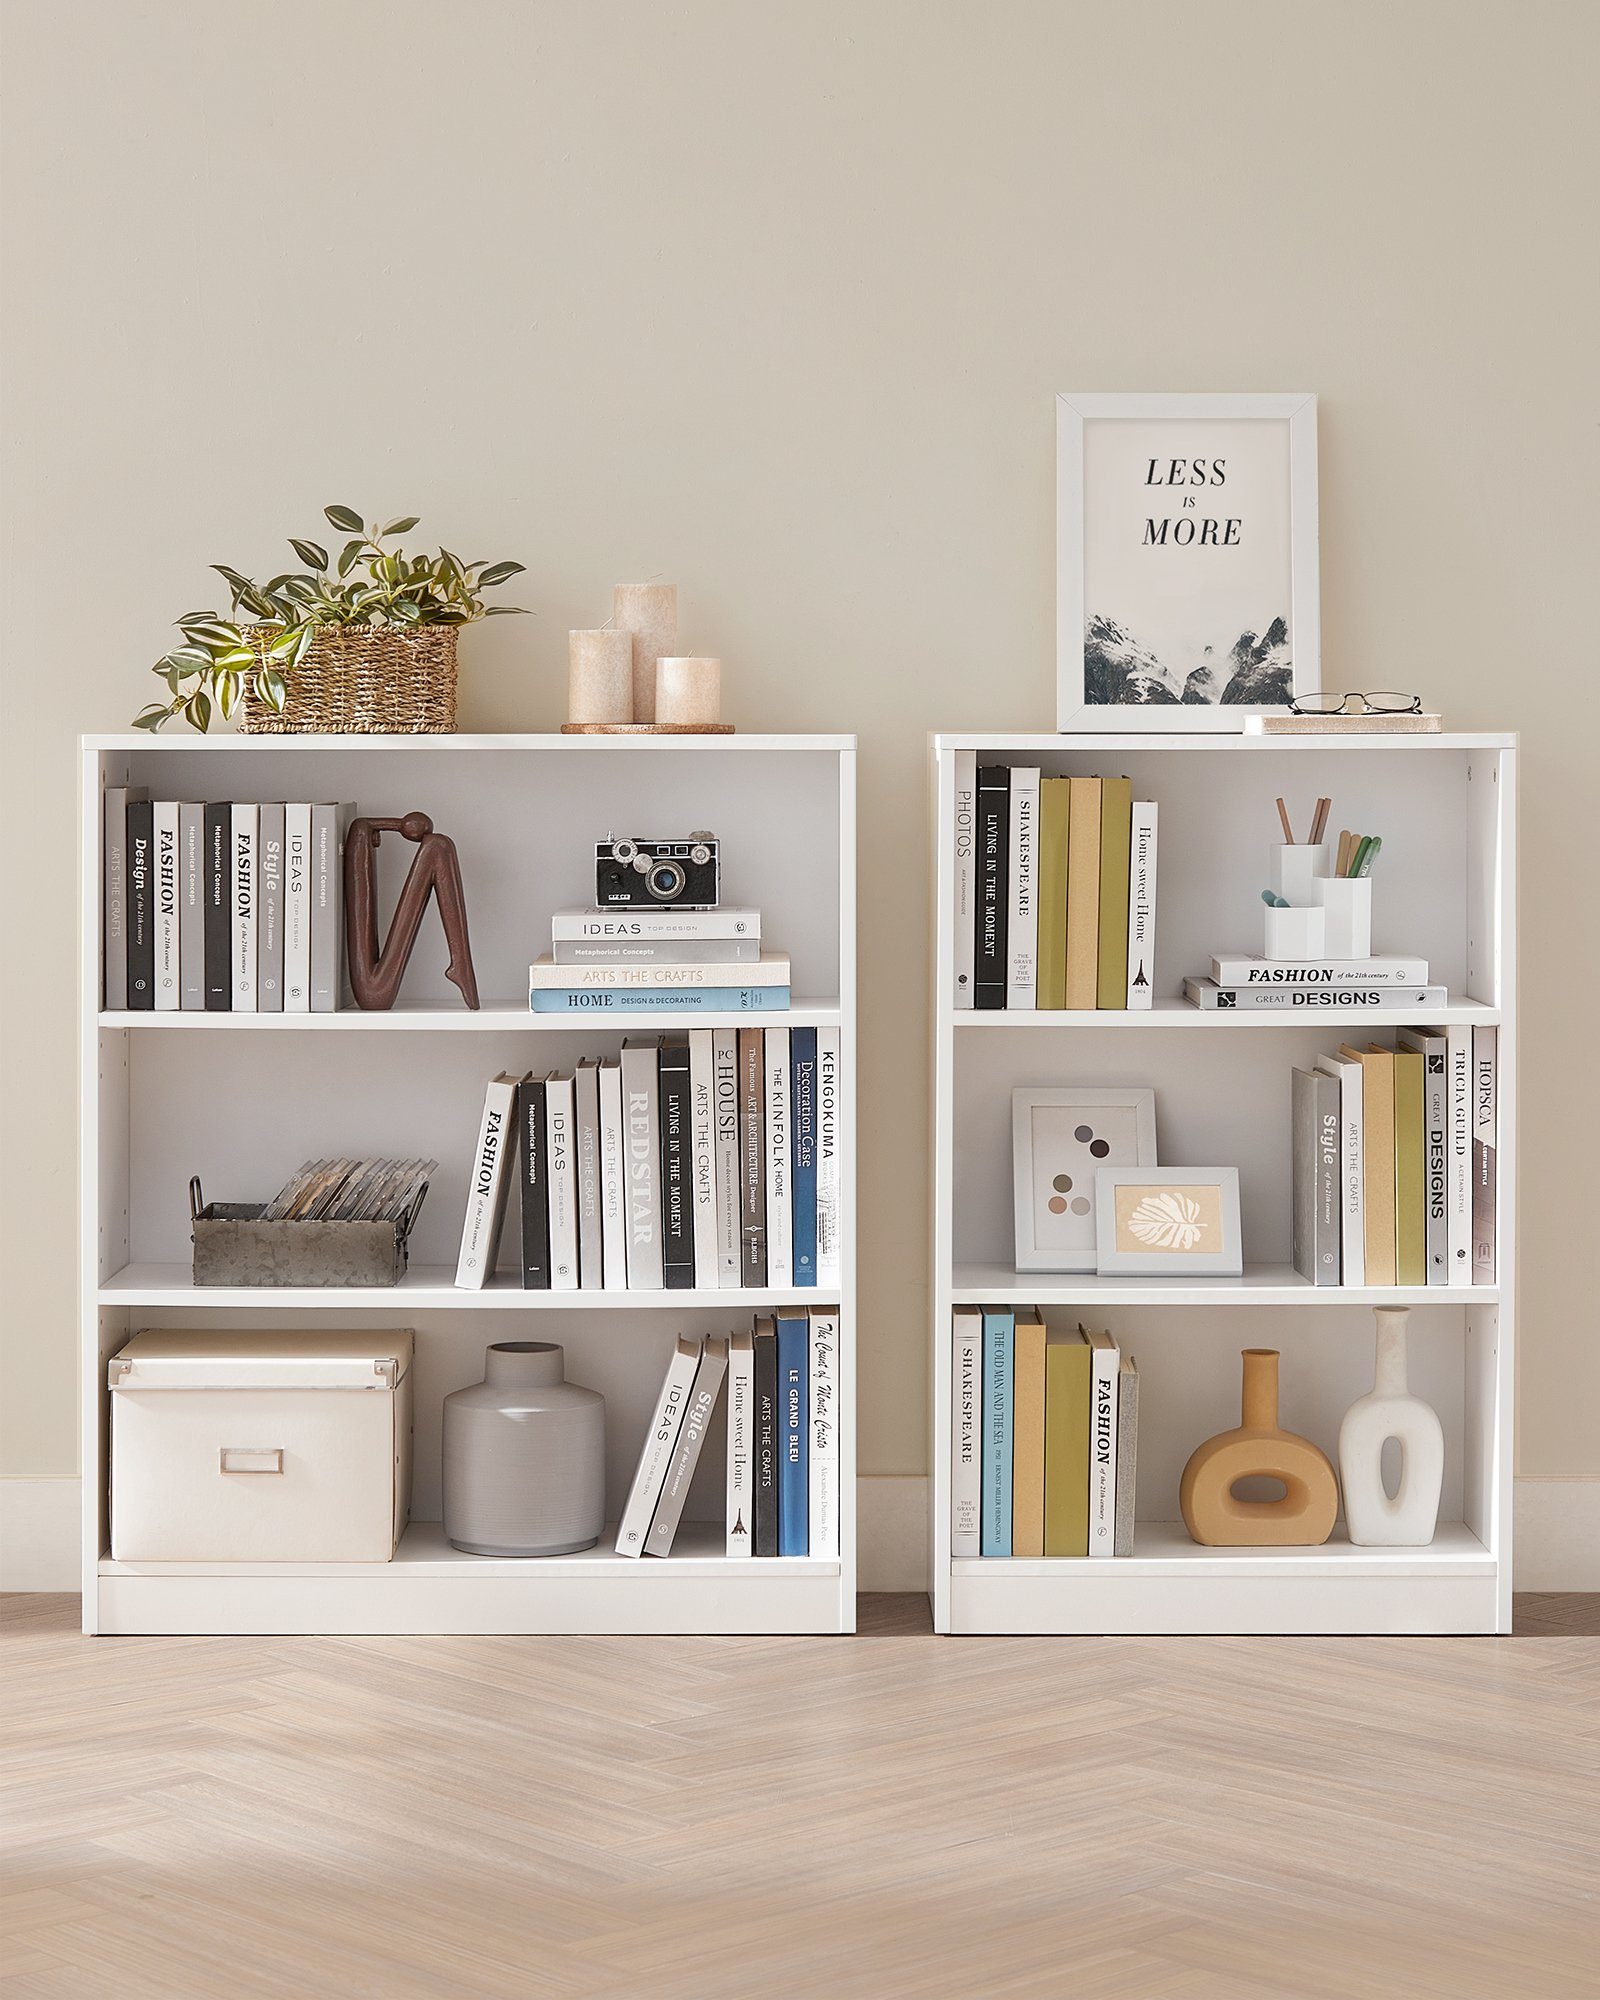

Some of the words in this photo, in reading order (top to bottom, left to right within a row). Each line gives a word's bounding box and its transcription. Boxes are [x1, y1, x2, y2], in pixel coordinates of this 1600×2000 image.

[1144, 458, 1226, 486] LESS
[1183, 496, 1196, 508] IS
[1141, 518, 1242, 546] MORE
[957, 791, 972, 858] PHOTOS
[987, 814, 999, 854] LIVING
[111, 846, 120, 871] ARTS
[214, 825, 222, 871] Metaphorical
[320, 827, 328, 873] Metaphorical
[1019, 801, 1030, 917] SHAKESPEARE
[1138, 827, 1151, 864] Home
[133, 838, 147, 890] Design
[161, 830, 174, 916] FASHION
[238, 833, 251, 920] FASHION
[263, 840, 280, 891] Style
[292, 834, 302, 894] IDEAS
[986, 860, 997, 871] IN
[111, 876, 120, 895] THE
[214, 873, 222, 906] Concepts
[320, 875, 328, 908] Concepts
[986, 877, 997, 900] THE
[1137, 868, 1149, 901] sweet
[111, 900, 120, 937] CRAFTS
[164, 927, 172, 936] the
[241, 922, 248, 930] of
[583, 923, 641, 935] IDEAS
[985, 906, 997, 957] MOMENT
[1136, 905, 1149, 943] Home
[164, 950, 172, 972] century
[575, 949, 620, 957] Metaphorical
[622, 948, 655, 957] Concepts
[583, 970, 616, 983] ARTS
[622, 970, 648, 983] THE
[654, 970, 704, 982] CRAFTS
[1248, 969, 1334, 982] FASHION
[567, 994, 613, 1007] HOME
[621, 997, 648, 1005] DESIGN
[655, 997, 702, 1005] DECORATING
[1255, 995, 1286, 1003] GREAT
[1292, 992, 1380, 1005] DESIGNS
[718, 1050, 734, 1060] PC
[749, 1048, 757, 1061] The
[749, 1063, 757, 1092] Famous
[774, 1068, 782, 1086] THE
[1455, 1049, 1466, 1104] TRICIA
[697, 1084, 708, 1116] ARTS
[718, 1065, 736, 1142] HOUSE
[801, 1061, 814, 1133] Decoration
[822, 1051, 834, 1159] KENGOKUMA
[1432, 1093, 1441, 1124] GREAT
[1479, 1060, 1492, 1127] HOPSCA
[529, 1104, 537, 1149] Metaphorical
[669, 1094, 680, 1134] LIVING
[773, 1092, 785, 1168] KINFOLK
[554, 1113, 565, 1171] IDEAS
[584, 1126, 593, 1150] ARTS
[606, 1127, 616, 1151] ARTS
[670, 1140, 680, 1152] IN
[698, 1122, 709, 1148] THE
[1320, 1115, 1337, 1165] Style
[1349, 1122, 1359, 1148] ARTS
[1455, 1108, 1466, 1156] GUILD
[477, 1110, 502, 1197] FASHION
[584, 1156, 594, 1174] THE
[606, 1157, 617, 1175] THE
[748, 1120, 758, 1185] ARCHITECTURE
[801, 1135, 814, 1168] Case
[1349, 1152, 1359, 1171] THE
[530, 1152, 538, 1184] Concepts
[629, 1090, 653, 1246] REDSTAR
[670, 1157, 680, 1180] THE
[698, 1155, 710, 1204] CRAFTS
[774, 1170, 783, 1198] HOME
[1430, 1130, 1444, 1219] DESIGNS
[584, 1180, 594, 1217] CRAFTS
[606, 1181, 617, 1218] CRAFTS
[1349, 1176, 1359, 1214] CRAFTS
[671, 1186, 682, 1237] MOMENT
[471, 1230, 479, 1251] century
[817, 1323, 833, 1339] The
[994, 1331, 1005, 1347] THE
[814, 1342, 833, 1367] Count
[994, 1350, 1005, 1367] OLD
[789, 1370, 799, 1382] LE
[813, 1368, 830, 1379] of
[994, 1370, 1005, 1389] MAN
[734, 1376, 747, 1413] Home
[762, 1395, 771, 1420] ARTS
[789, 1389, 799, 1427] GRAND
[815, 1384, 832, 1416] Monte
[961, 1348, 973, 1464] SHAKESPEARE
[993, 1391, 1004, 1410] AND
[657, 1384, 683, 1441] IDEAS
[687, 1391, 712, 1441] Style
[993, 1413, 1004, 1429] THE
[1097, 1378, 1111, 1465] FASHION
[734, 1417, 747, 1448] sweet
[762, 1426, 771, 1445] THE
[789, 1435, 799, 1462] BLEU
[814, 1420, 832, 1449] Cristo
[993, 1430, 1004, 1445] SEA
[734, 1453, 747, 1491] Home
[762, 1450, 771, 1487] CRAFTS
[820, 1465, 828, 1499] Alexandre
[820, 1501, 828, 1524] Dumas
